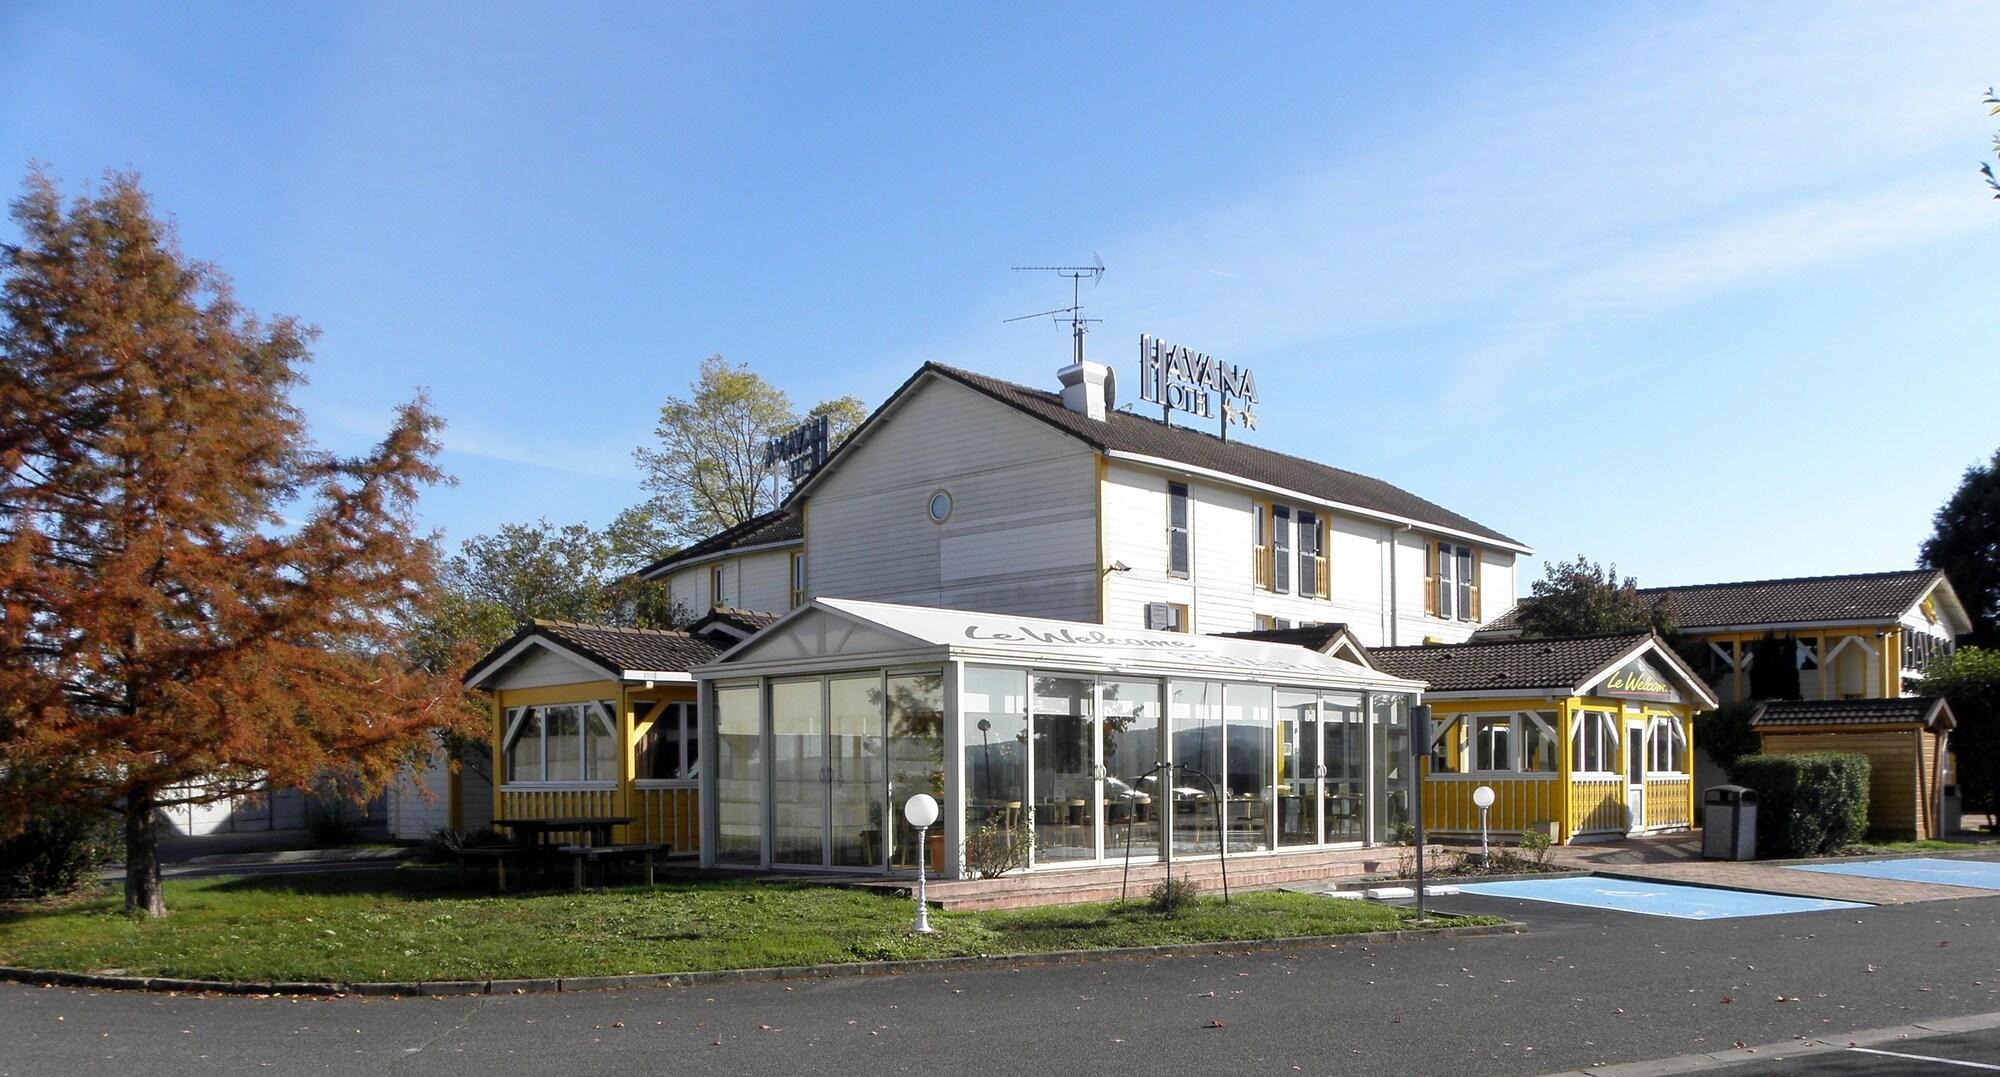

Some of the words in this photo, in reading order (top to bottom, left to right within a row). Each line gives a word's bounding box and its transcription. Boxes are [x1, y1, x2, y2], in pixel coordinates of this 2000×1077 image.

[1140, 333, 1259, 404] HAVANA
[965, 626, 1025, 641] Le
[1018, 627, 1196, 648] Welcome
[1607, 671, 1624, 689] Le
